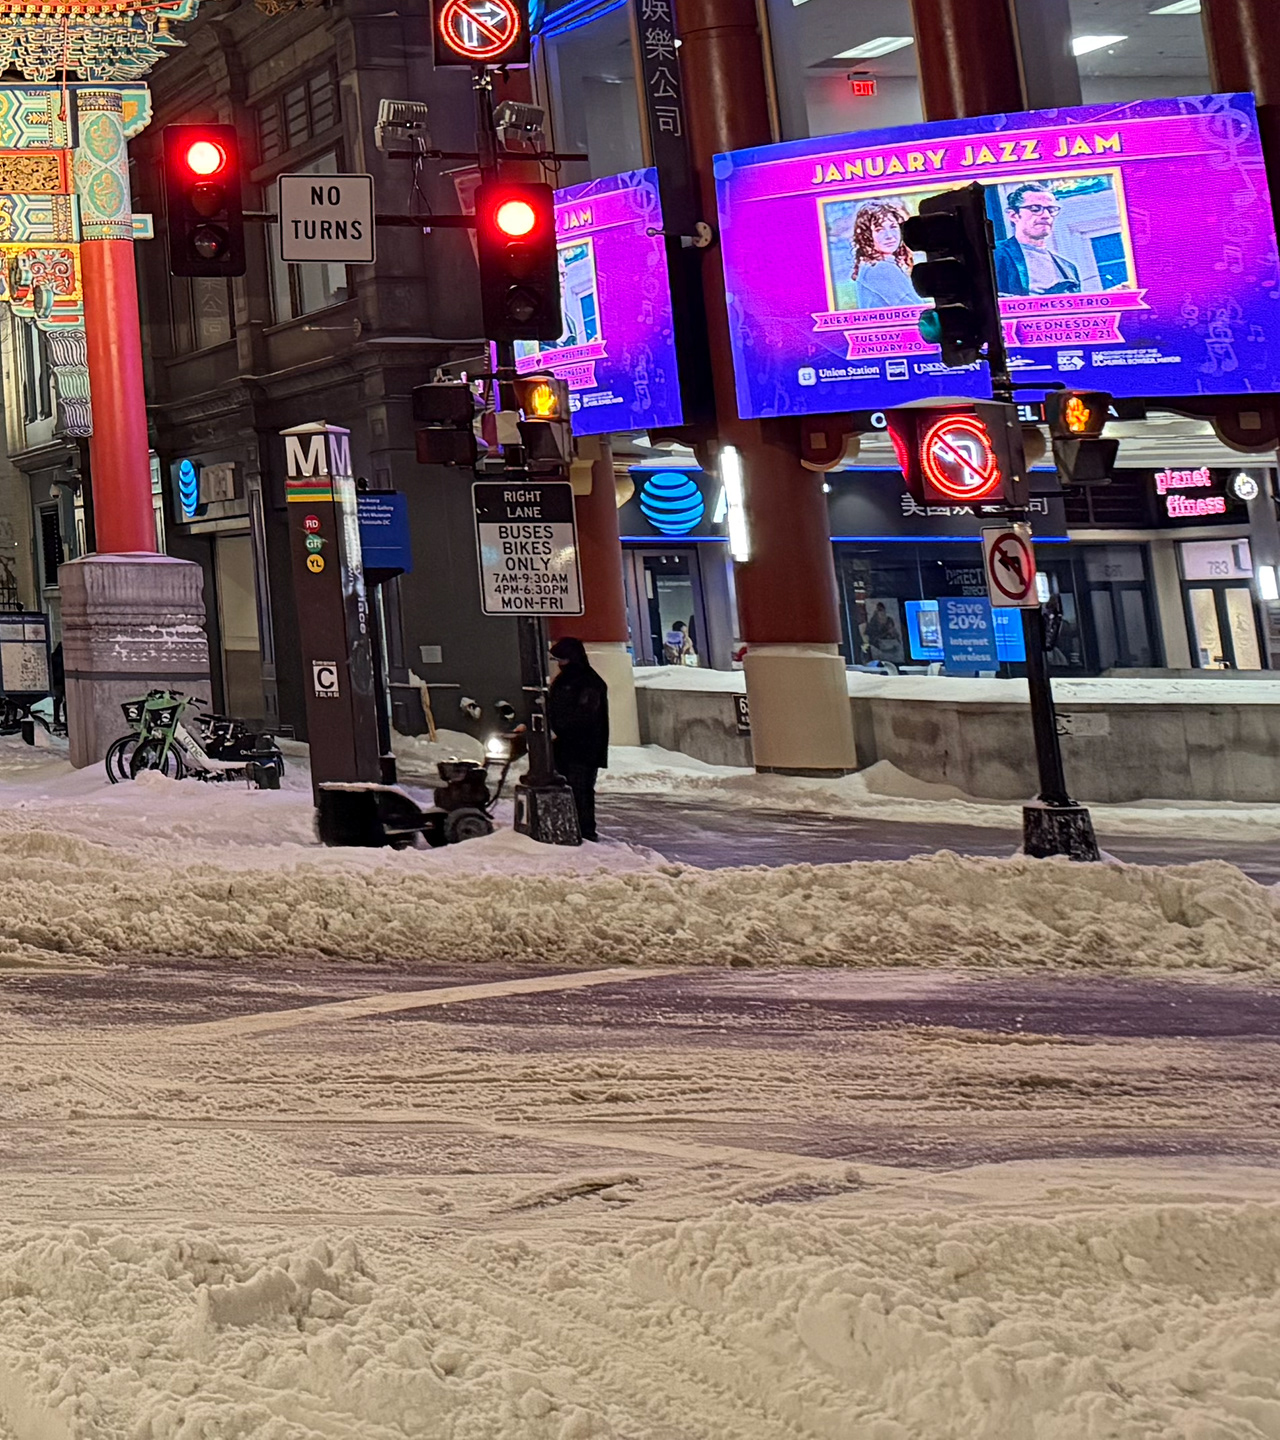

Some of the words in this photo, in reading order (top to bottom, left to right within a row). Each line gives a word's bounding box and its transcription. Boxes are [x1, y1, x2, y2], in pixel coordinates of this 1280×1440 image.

[811, 148, 944, 185] JANUARY
[960, 139, 1042, 167] JAZZ
[1053, 132, 1123, 158] JAM
[311, 186, 340, 205] NO
[562, 206, 593, 232] JAM
[291, 220, 362, 240] TURNS
[1008, 303, 1037, 311] HOT
[1040, 300, 1074, 308] MESS
[1079, 297, 1111, 306] TRIO
[823, 316, 849, 325] ALEX
[854, 311, 922, 323] HAMBURGE
[1023, 318, 1109, 331] WEDNESDAY
[855, 333, 901, 343] TUESDAY
[1028, 331, 1090, 343] JANUARY
[1098, 330, 1112, 339] 21
[856, 343, 903, 355] JANUARY
[908, 342, 922, 351] 20
[285, 435, 328, 476] M
[329, 435, 352, 475] M
[1155, 466, 1212, 495] planet
[504, 491, 541, 502] RIGHT
[507, 507, 541, 518] LANE
[1167, 495, 1226, 517] fitness
[306, 520, 319, 528] RD
[499, 525, 553, 539] BUSES
[306, 539, 321, 549] GR
[503, 541, 552, 555] BIKES
[309, 559, 321, 568] YL
[506, 557, 551, 571] ONLY
[1207, 561, 1229, 575] 783
[493, 573, 568, 584] 7AM-9:30AM
[494, 585, 568, 595] 4PM-6:30PM
[502, 597, 564, 609] MON-FRI
[947, 601, 983, 615] Save
[948, 614, 987, 630] 20%
[951, 653, 990, 662] wireless
[317, 667, 335, 690] C
